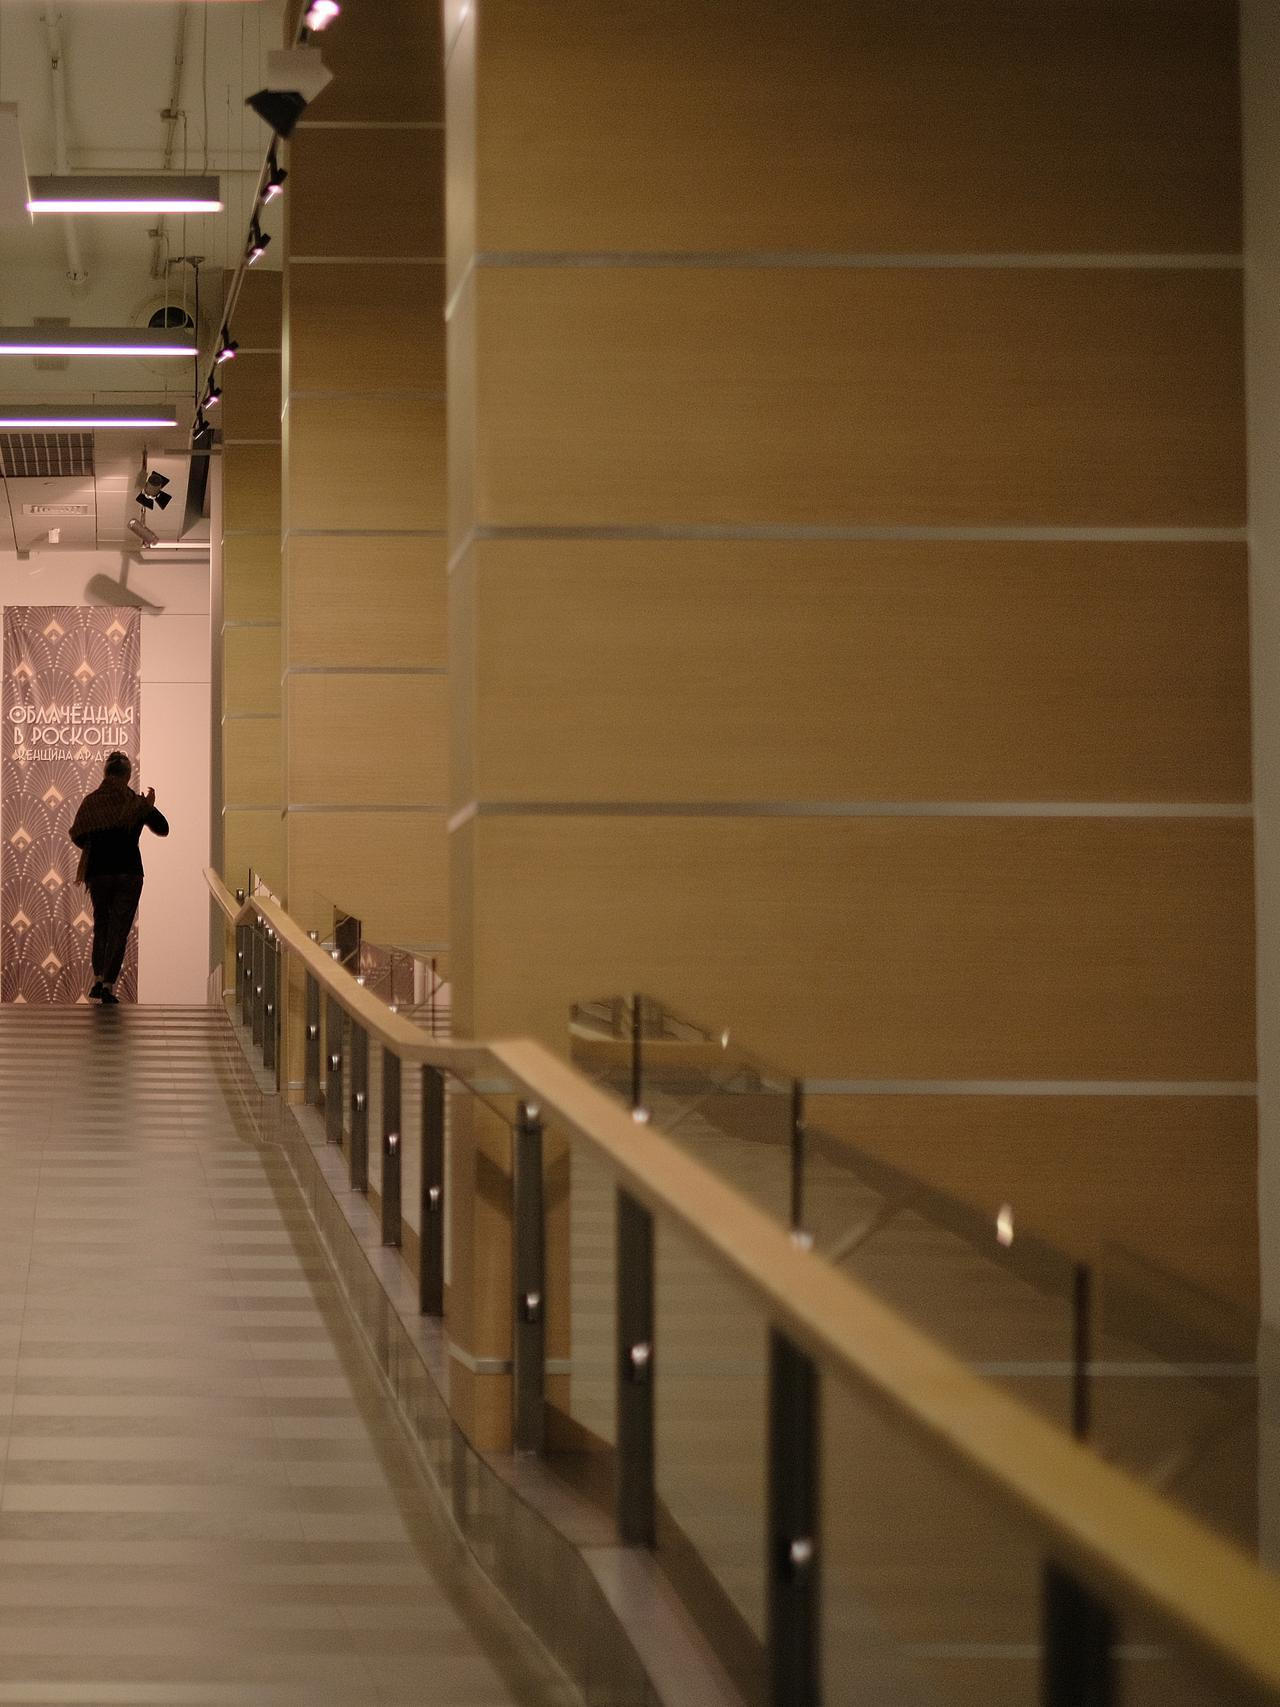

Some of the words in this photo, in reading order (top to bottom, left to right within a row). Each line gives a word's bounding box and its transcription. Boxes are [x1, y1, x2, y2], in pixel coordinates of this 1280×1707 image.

[9, 704, 134, 724] ОБЛАЧЁННАЯ
[14, 727, 24, 745] В
[31, 727, 129, 745] РОСКОШЬ
[14, 750, 73, 762] ЖЕНЩИНА
